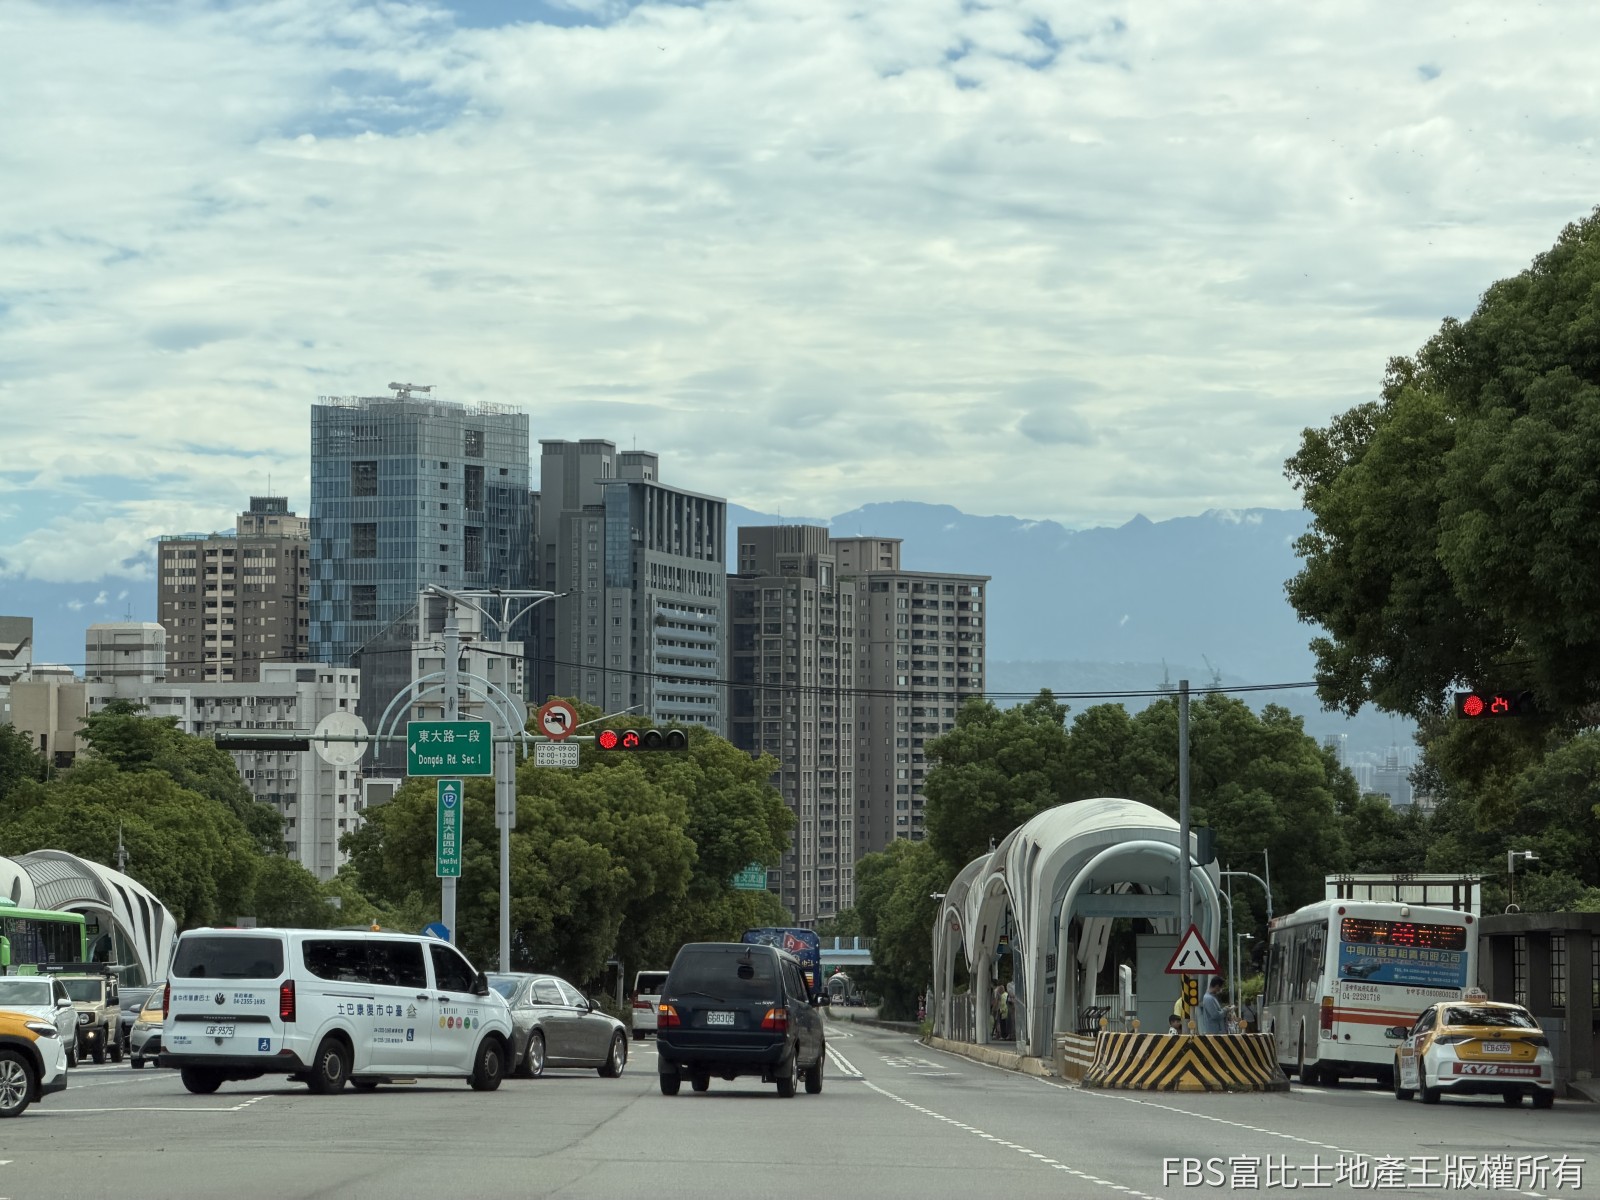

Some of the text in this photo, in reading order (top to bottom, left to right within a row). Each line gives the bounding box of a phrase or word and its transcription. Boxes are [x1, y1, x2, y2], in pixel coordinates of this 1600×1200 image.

[1491, 696, 1508, 713] 24
[418, 729, 481, 743] 東大路一段
[623, 733, 639, 748] 24
[418, 754, 444, 768] Dongda
[447, 754, 458, 765] Rd.
[445, 794, 455, 803] 12
[1461, 1063, 1499, 1075] KYB
